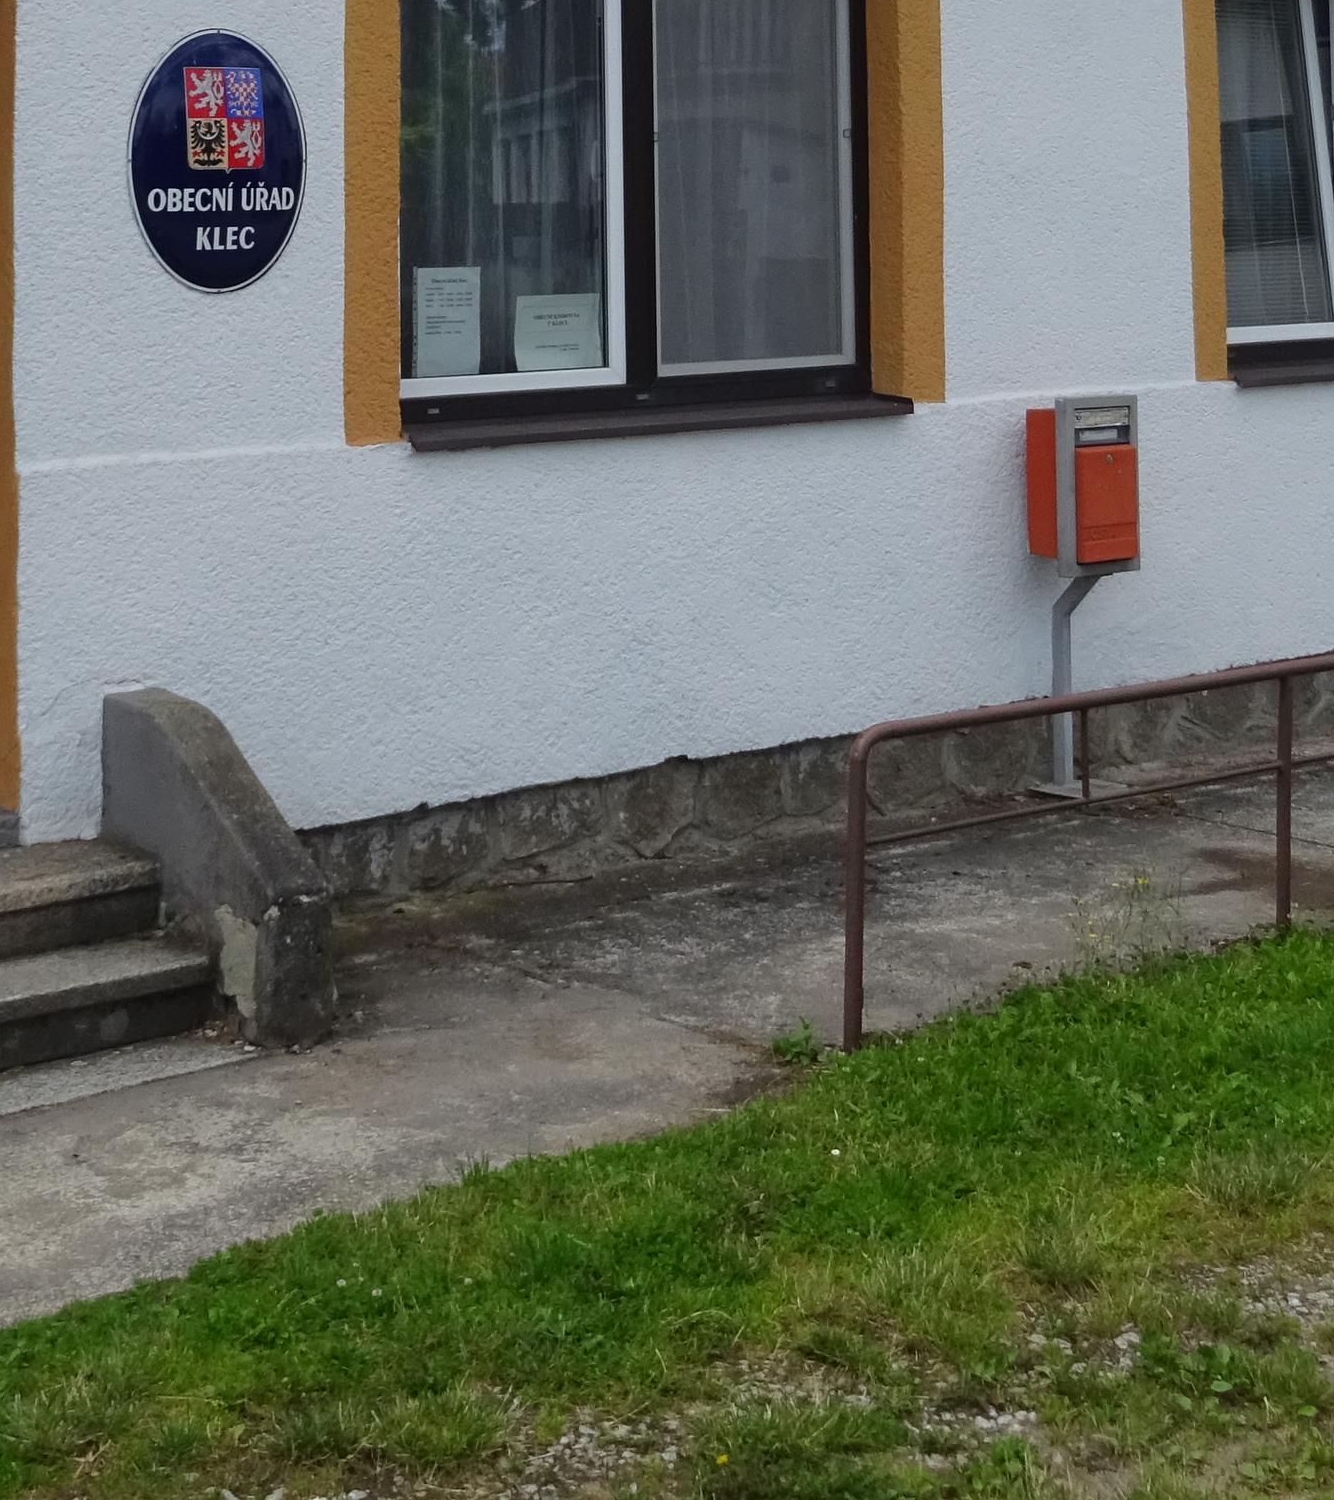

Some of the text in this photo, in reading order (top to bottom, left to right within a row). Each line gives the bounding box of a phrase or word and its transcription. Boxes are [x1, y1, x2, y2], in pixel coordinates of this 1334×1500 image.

[147, 182, 295, 212] OBECNÍ ÚŘAD
[196, 226, 256, 251] KLEC
